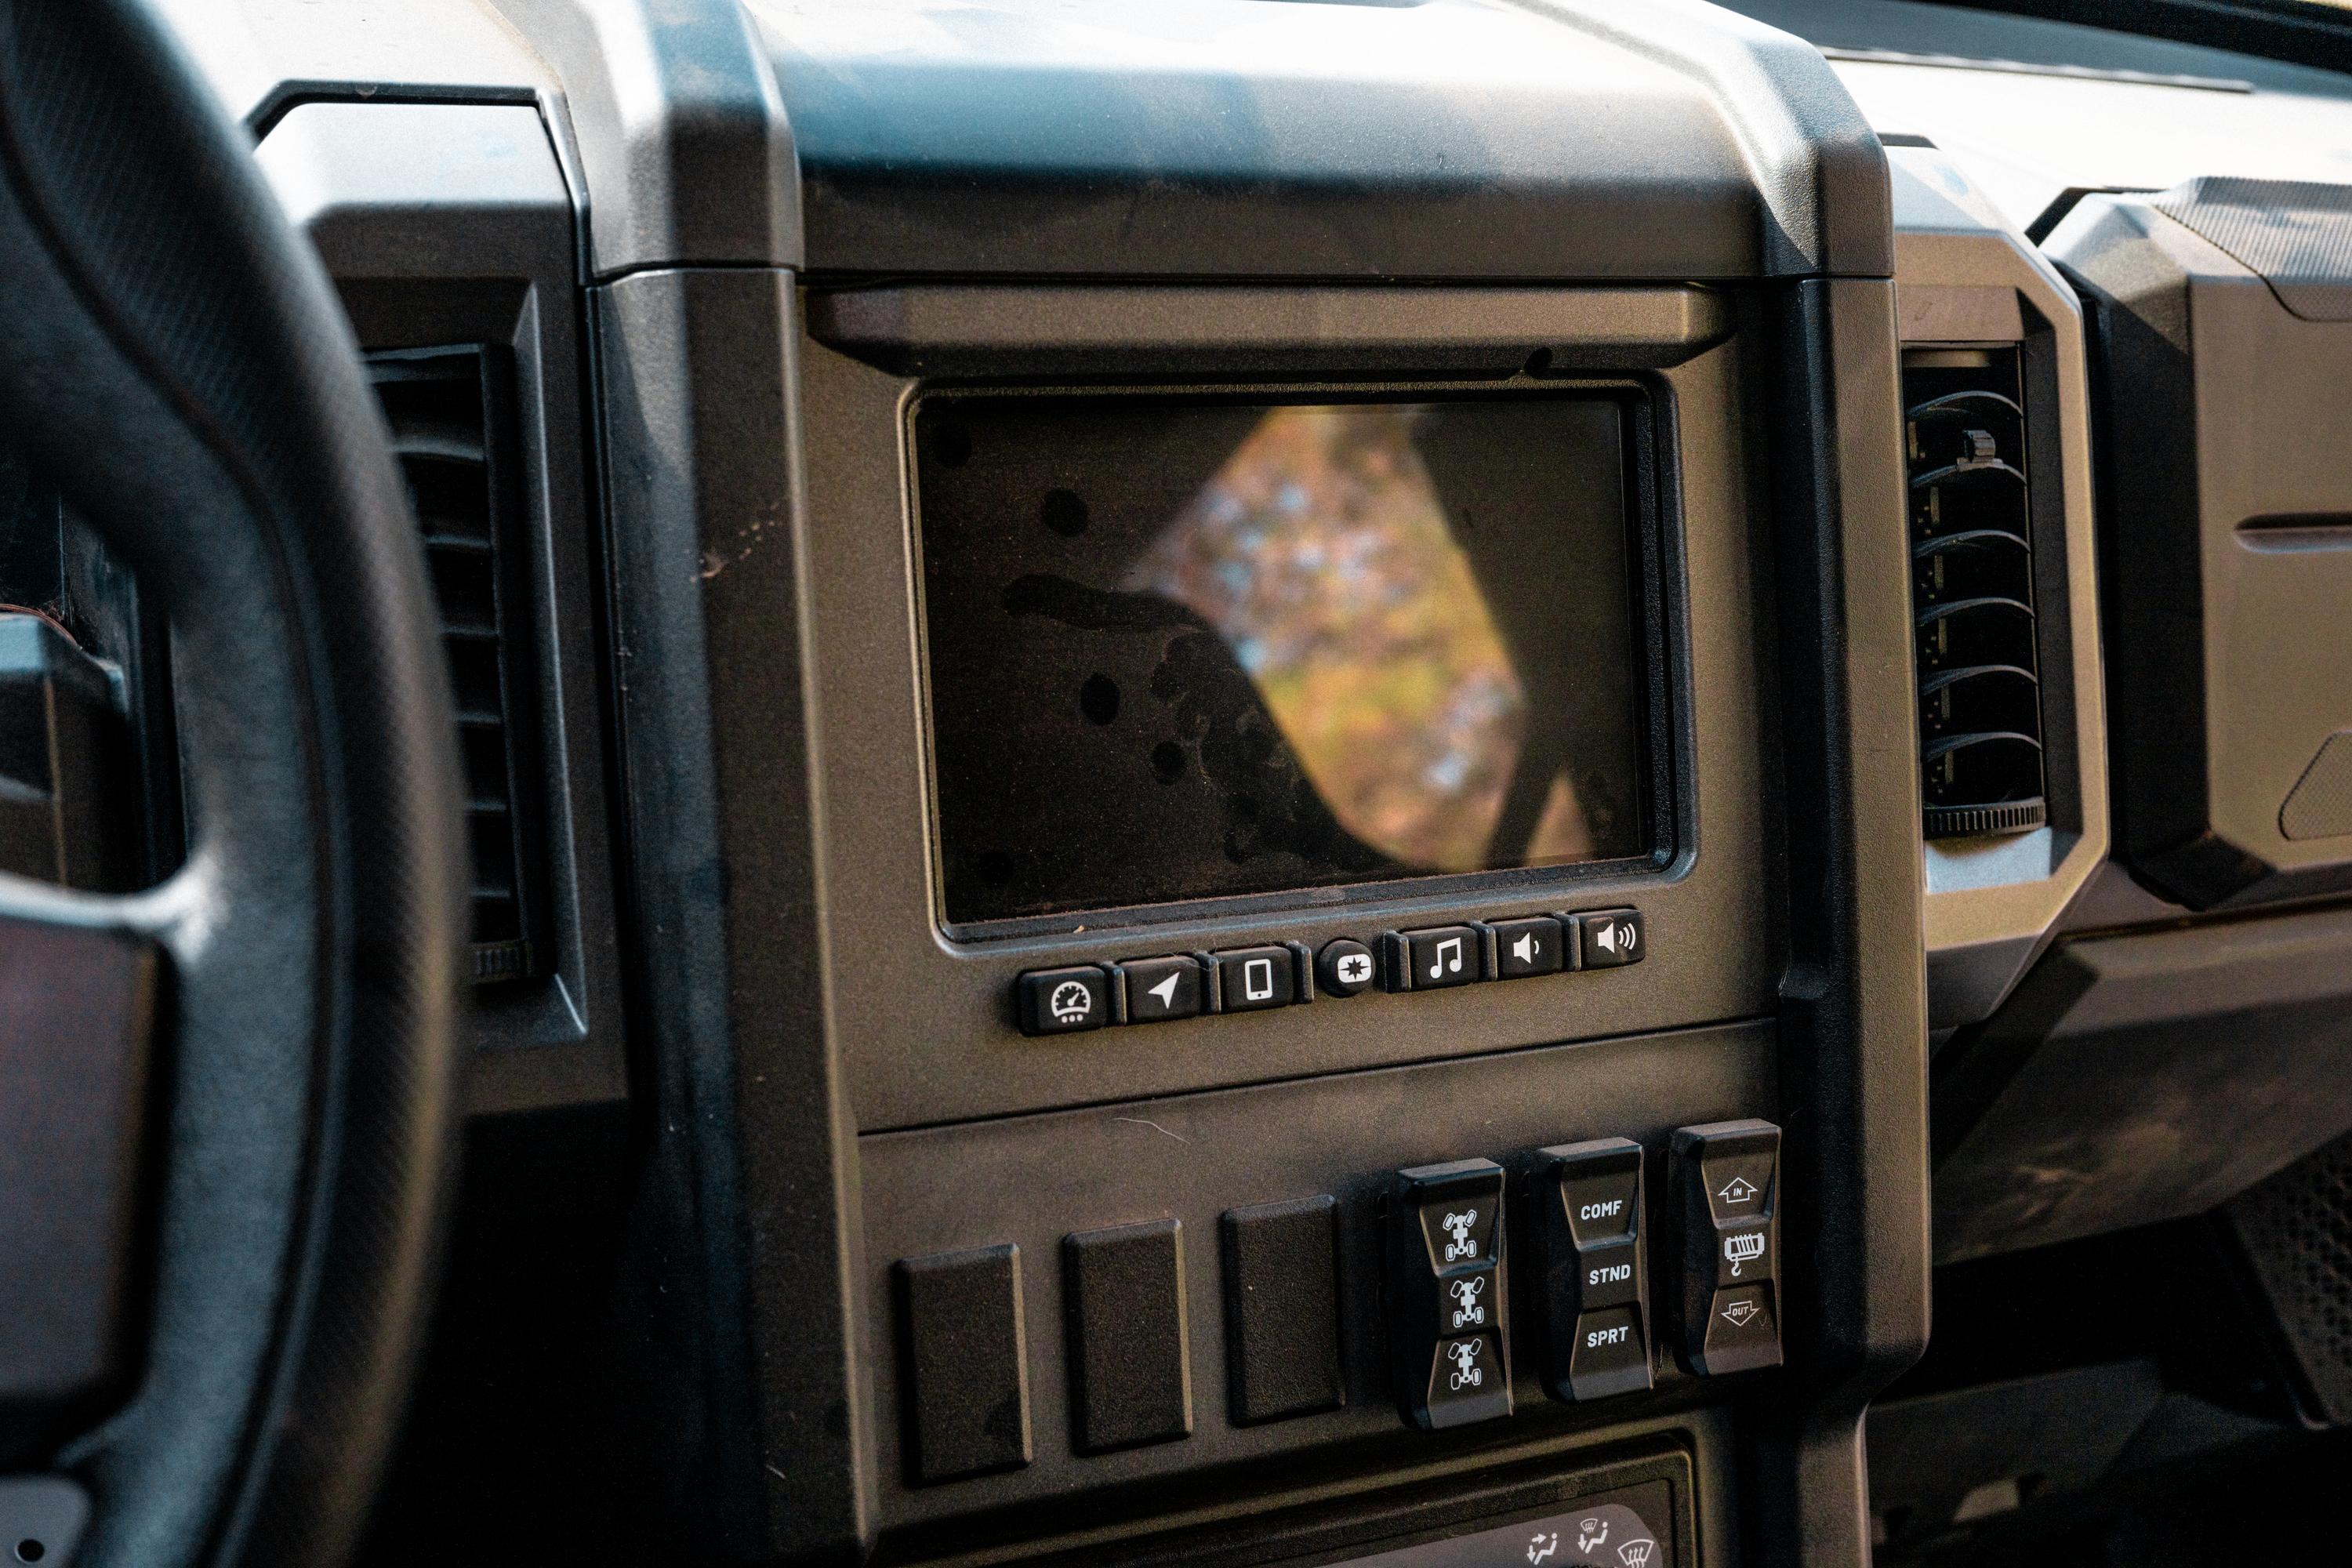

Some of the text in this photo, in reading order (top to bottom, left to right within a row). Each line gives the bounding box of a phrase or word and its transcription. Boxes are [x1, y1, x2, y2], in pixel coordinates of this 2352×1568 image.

[1733, 1187, 1742, 1196] IN
[1581, 1200, 1622, 1220] COMF
[1589, 1264, 1631, 1285] STND
[1732, 1306, 1749, 1316] OUT
[1587, 1326, 1628, 1348] SPRT
